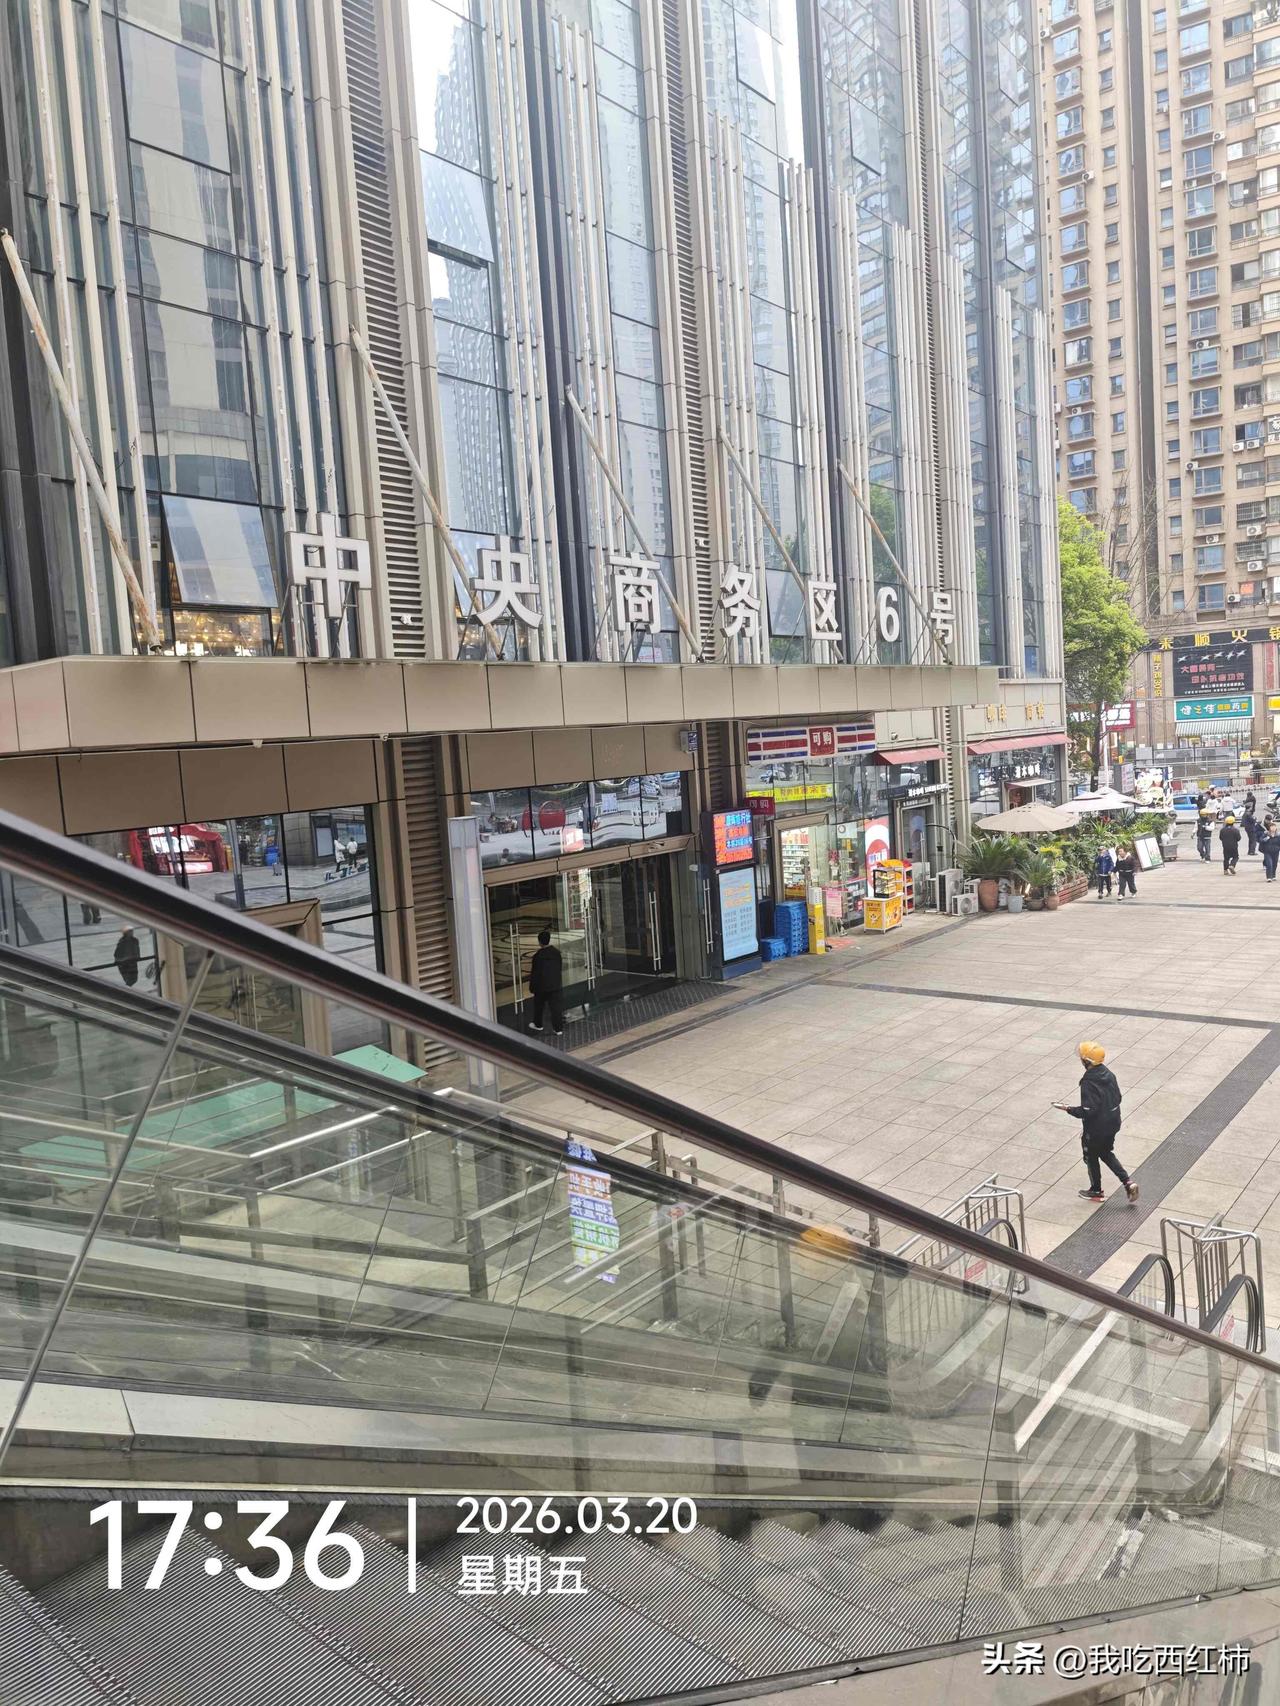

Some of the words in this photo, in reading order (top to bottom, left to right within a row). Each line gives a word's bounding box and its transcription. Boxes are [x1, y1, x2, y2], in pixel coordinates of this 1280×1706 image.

[285, 512, 956, 645] 中央商务区6号
[811, 731, 833, 747] 可购
